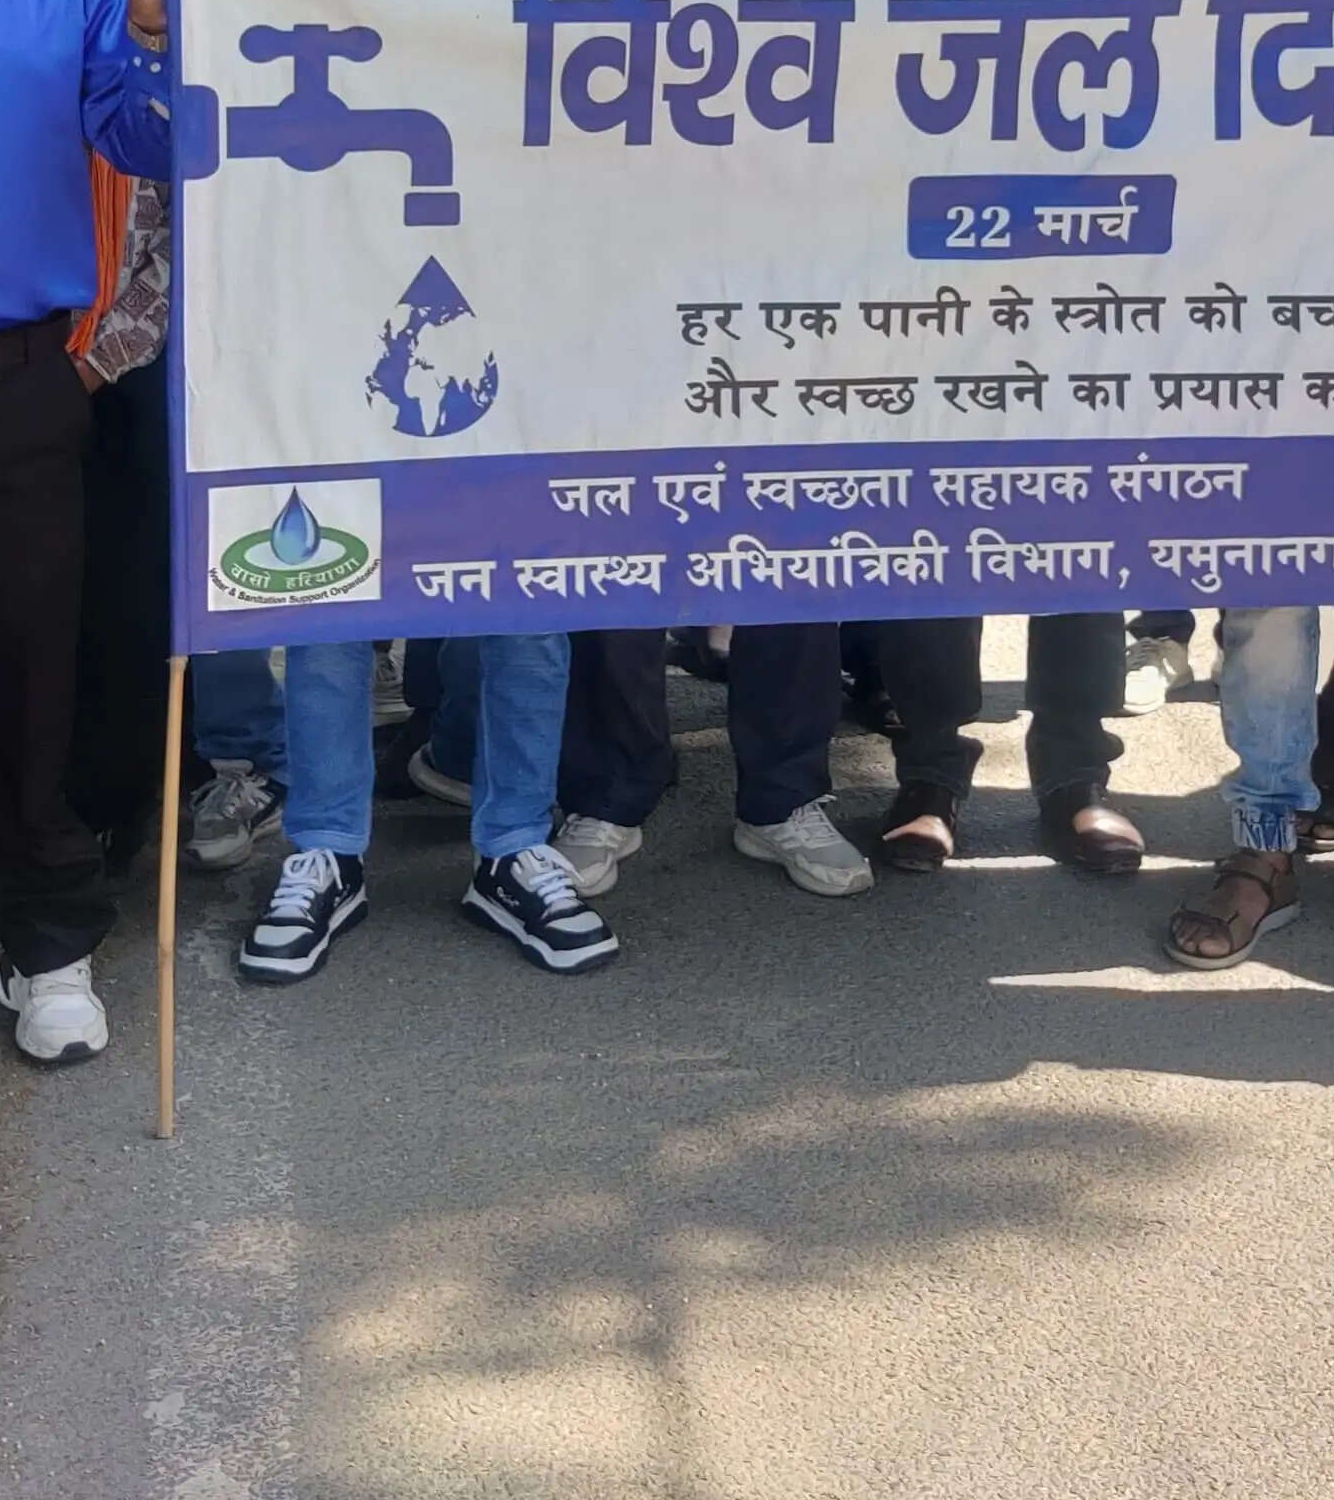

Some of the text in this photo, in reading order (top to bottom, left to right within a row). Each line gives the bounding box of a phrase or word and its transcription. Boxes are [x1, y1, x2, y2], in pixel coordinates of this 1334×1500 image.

[946, 186, 1138, 247] 22 मार्च
[676, 303, 742, 345] हर
[759, 302, 841, 349] एक
[859, 286, 971, 337] पानी
[989, 285, 1033, 334] के
[1051, 283, 1166, 334] स्त्रोत
[1185, 282, 1247, 333] को
[685, 357, 779, 418] और
[795, 377, 918, 415] स्वच्छ
[934, 360, 1049, 413] रखने
[1068, 374, 1131, 411] का
[1150, 373, 1284, 410] प्रयास
[549, 452, 1248, 523] जल एवं स्वच्छता सहायक संगठन
[412, 561, 496, 602] जन
[513, 555, 666, 598] स्वास्थ्य
[687, 530, 949, 591] अभियांत्रिकी
